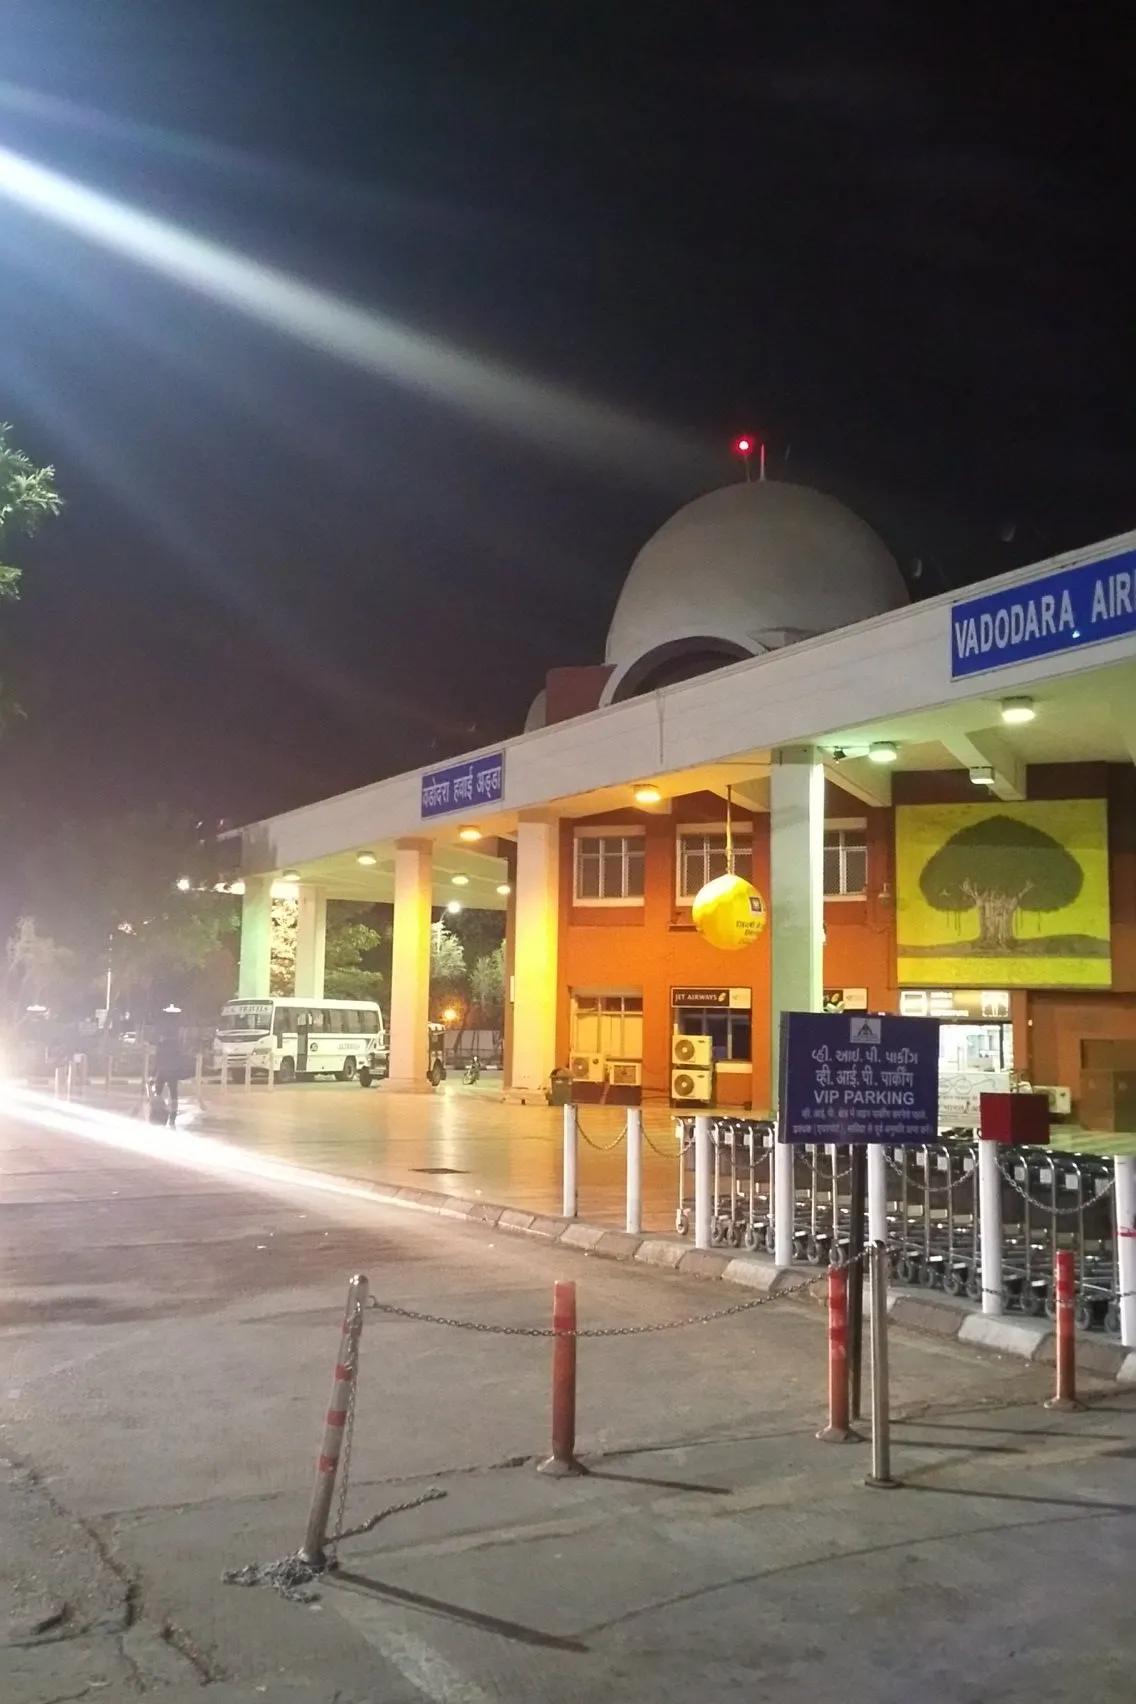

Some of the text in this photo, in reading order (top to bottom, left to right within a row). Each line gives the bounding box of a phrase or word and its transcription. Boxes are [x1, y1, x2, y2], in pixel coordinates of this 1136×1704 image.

[955, 571, 1136, 659] VADODARA AIR
[453, 765, 474, 803] हवाई
[675, 993, 717, 1001] JET AIRWAYS
[814, 1090, 915, 1105] VIP PARKING
